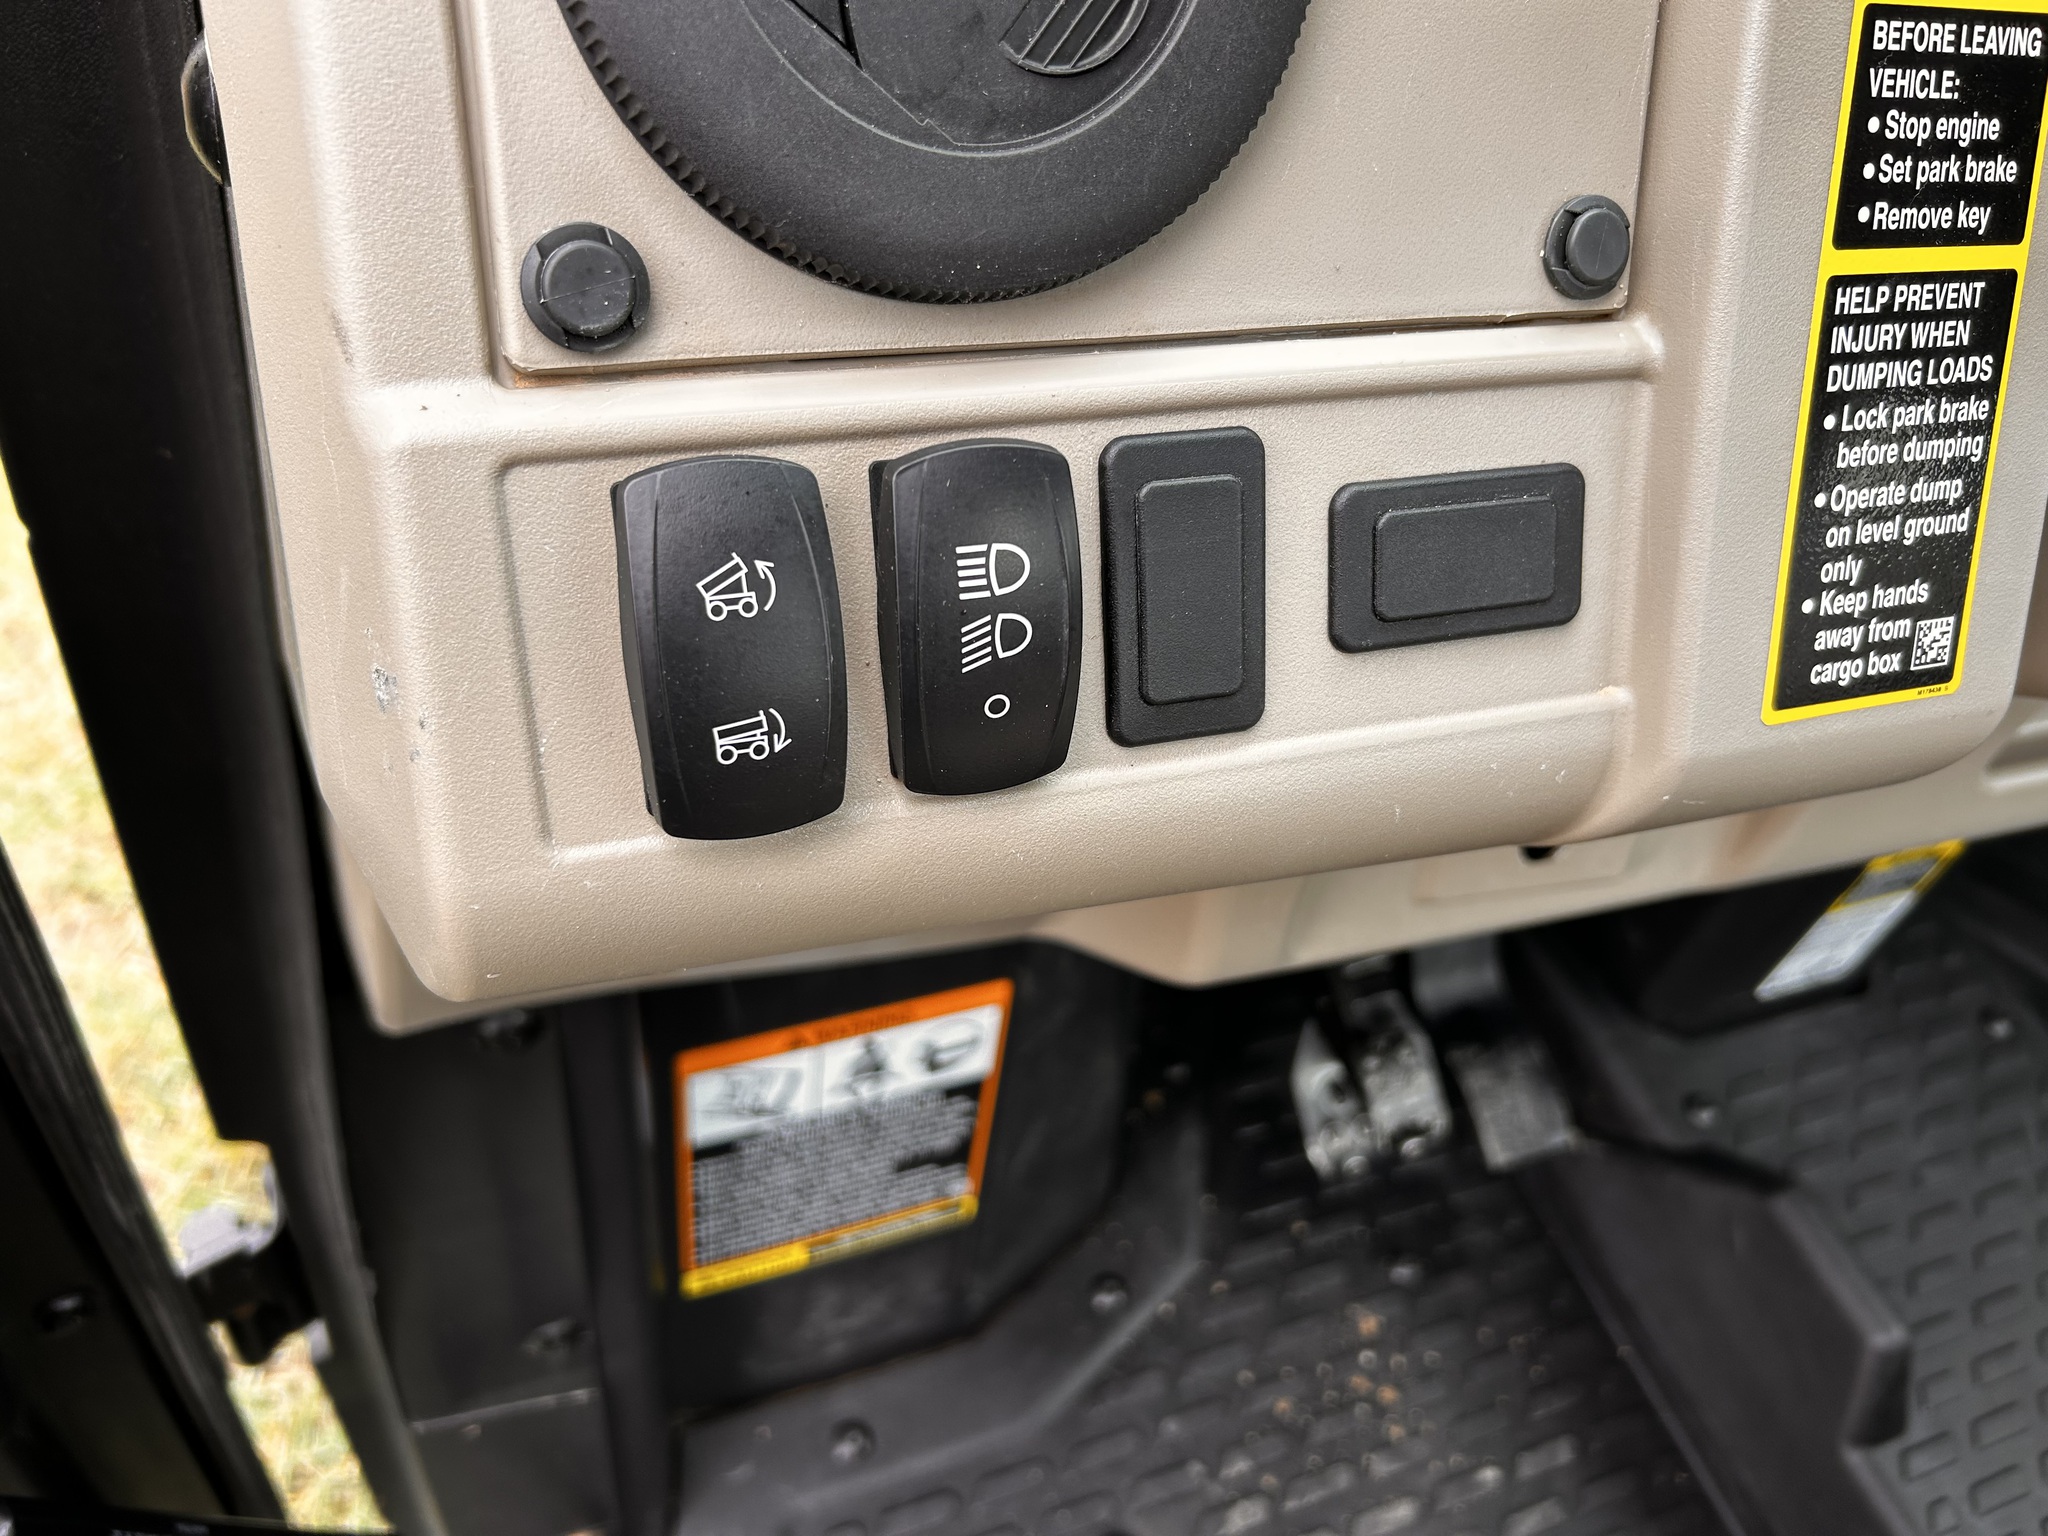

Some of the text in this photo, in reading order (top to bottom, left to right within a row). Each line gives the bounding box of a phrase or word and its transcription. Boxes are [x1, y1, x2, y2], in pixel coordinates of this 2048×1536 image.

[1873, 20, 2042, 57] BEFORE LEAVING
[1869, 68, 1960, 99] VEHICLE:
[1884, 109, 2000, 147] Stop engine
[1878, 154, 2018, 190] Set park brake
[1872, 201, 1991, 235] Remove key
[1834, 281, 1985, 315] HELP PREVENT
[1830, 320, 1971, 353] INJURY WHEN
[1826, 354, 1994, 392] DUMPING LOADS
[1841, 395, 1989, 434] Lock park brake
[1836, 432, 1984, 468] before dumping
[1830, 477, 1962, 516] Operate dump
[1825, 507, 1970, 548] on level ground
[1820, 554, 1862, 585] only
[1819, 578, 1929, 618] Keep hands
[1814, 617, 1911, 651] away from
[1810, 651, 1901, 686] cargo box
